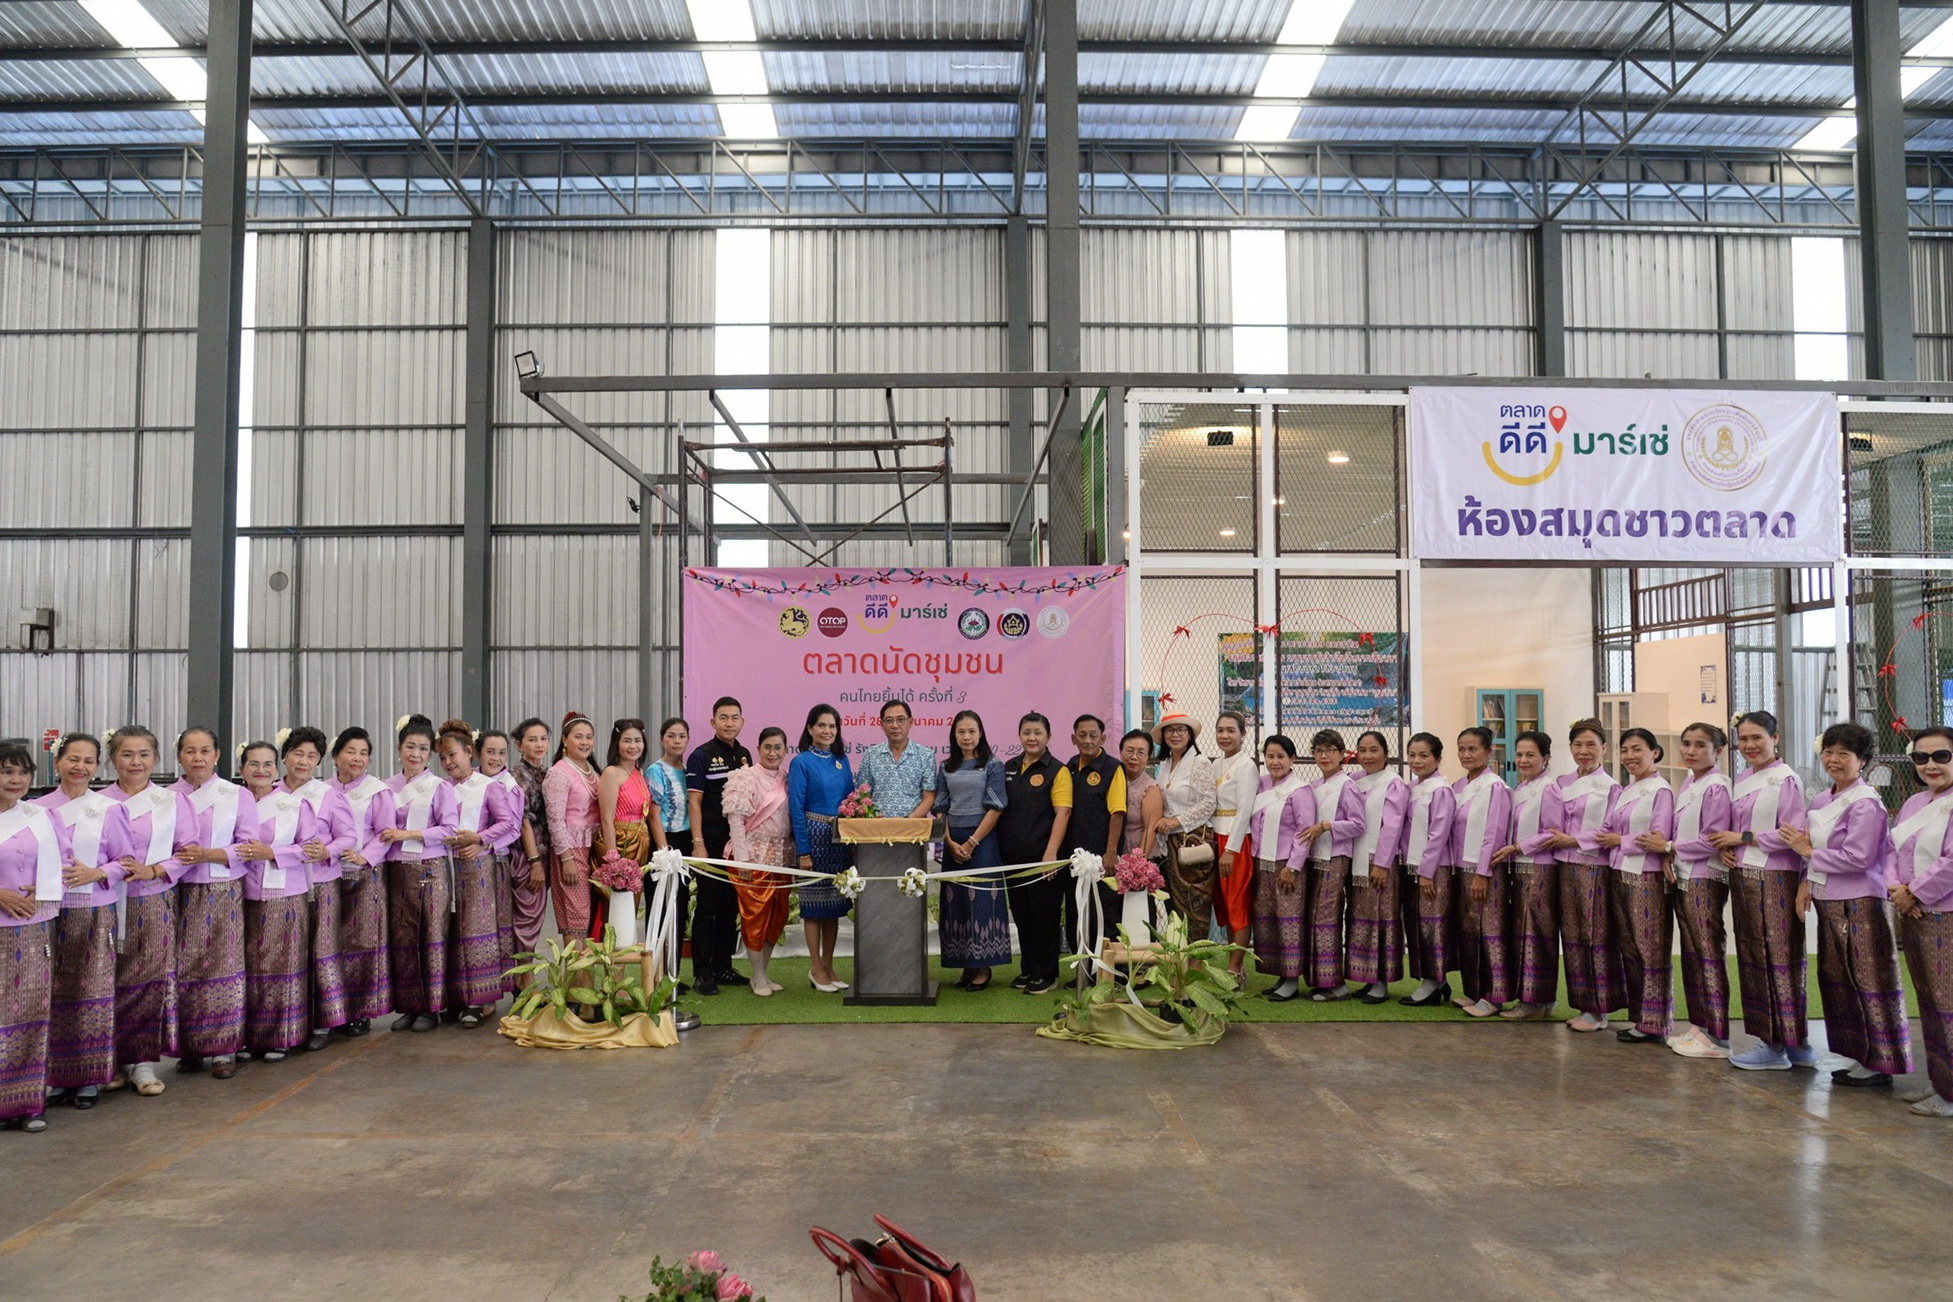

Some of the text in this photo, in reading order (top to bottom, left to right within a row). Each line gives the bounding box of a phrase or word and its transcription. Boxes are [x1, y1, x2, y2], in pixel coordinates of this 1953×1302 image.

[1500, 404, 1546, 418] ตลาด
[1499, 422, 1547, 454] ดีดี
[1573, 423, 1669, 455] มาร์เช่
[1457, 495, 1796, 548] ห้องสมุดชาวตลาด
[865, 594, 888, 602] ตลาด
[864, 603, 888, 619] ดีดี
[900, 603, 948, 619] มาร์เช่
[819, 616, 846, 625] OTOP
[803, 645, 1004, 683] ตลาดนัดชุมชน
[919, 686, 953, 703] ครั้งที่
[956, 690, 967, 704] 3
